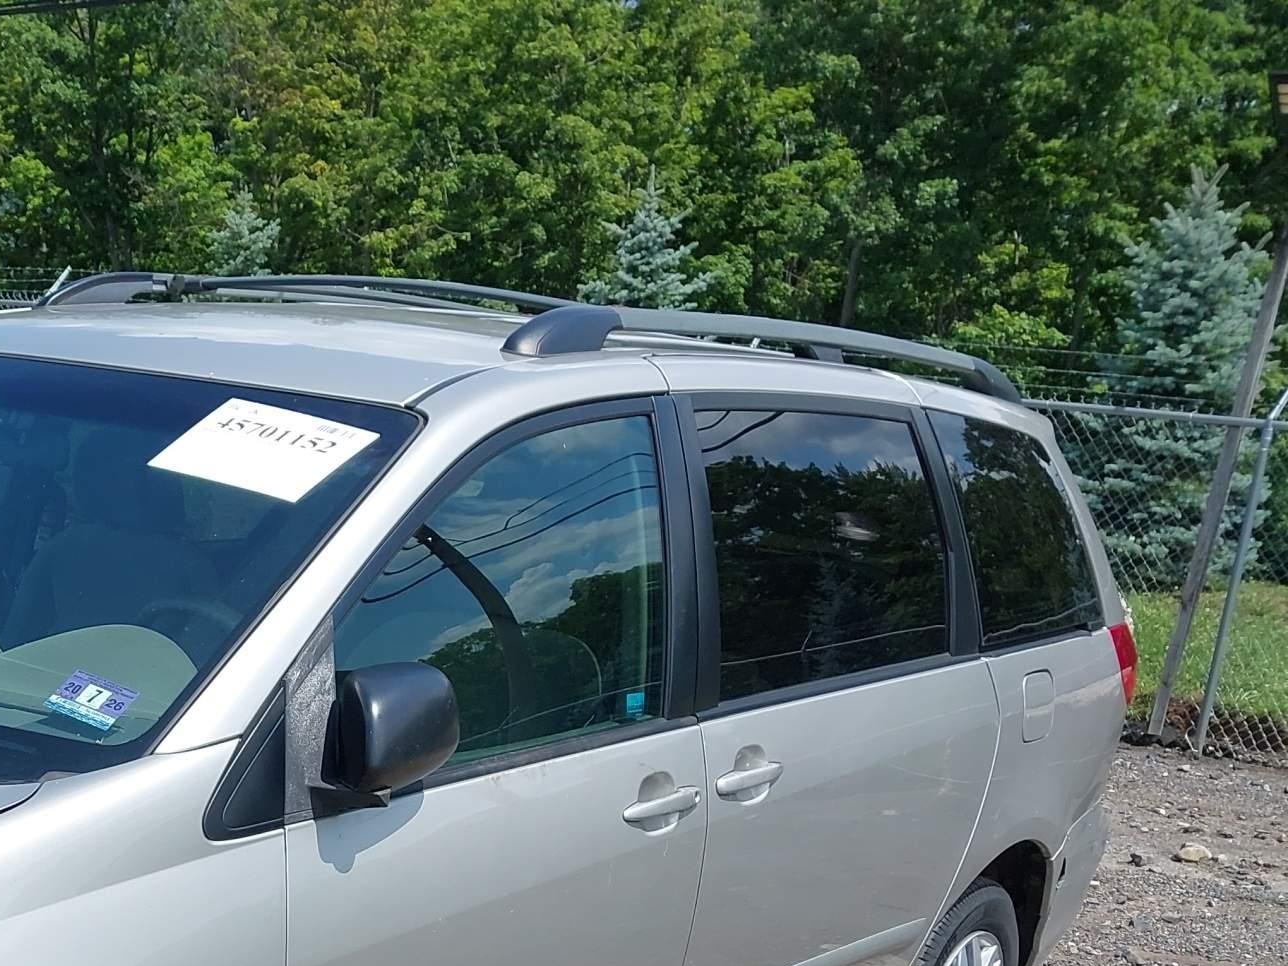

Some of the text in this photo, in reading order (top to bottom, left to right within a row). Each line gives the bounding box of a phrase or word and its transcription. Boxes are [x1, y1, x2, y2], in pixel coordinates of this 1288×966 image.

[217, 418, 337, 453] 45701152
[64, 682, 125, 711] 20 7 26
